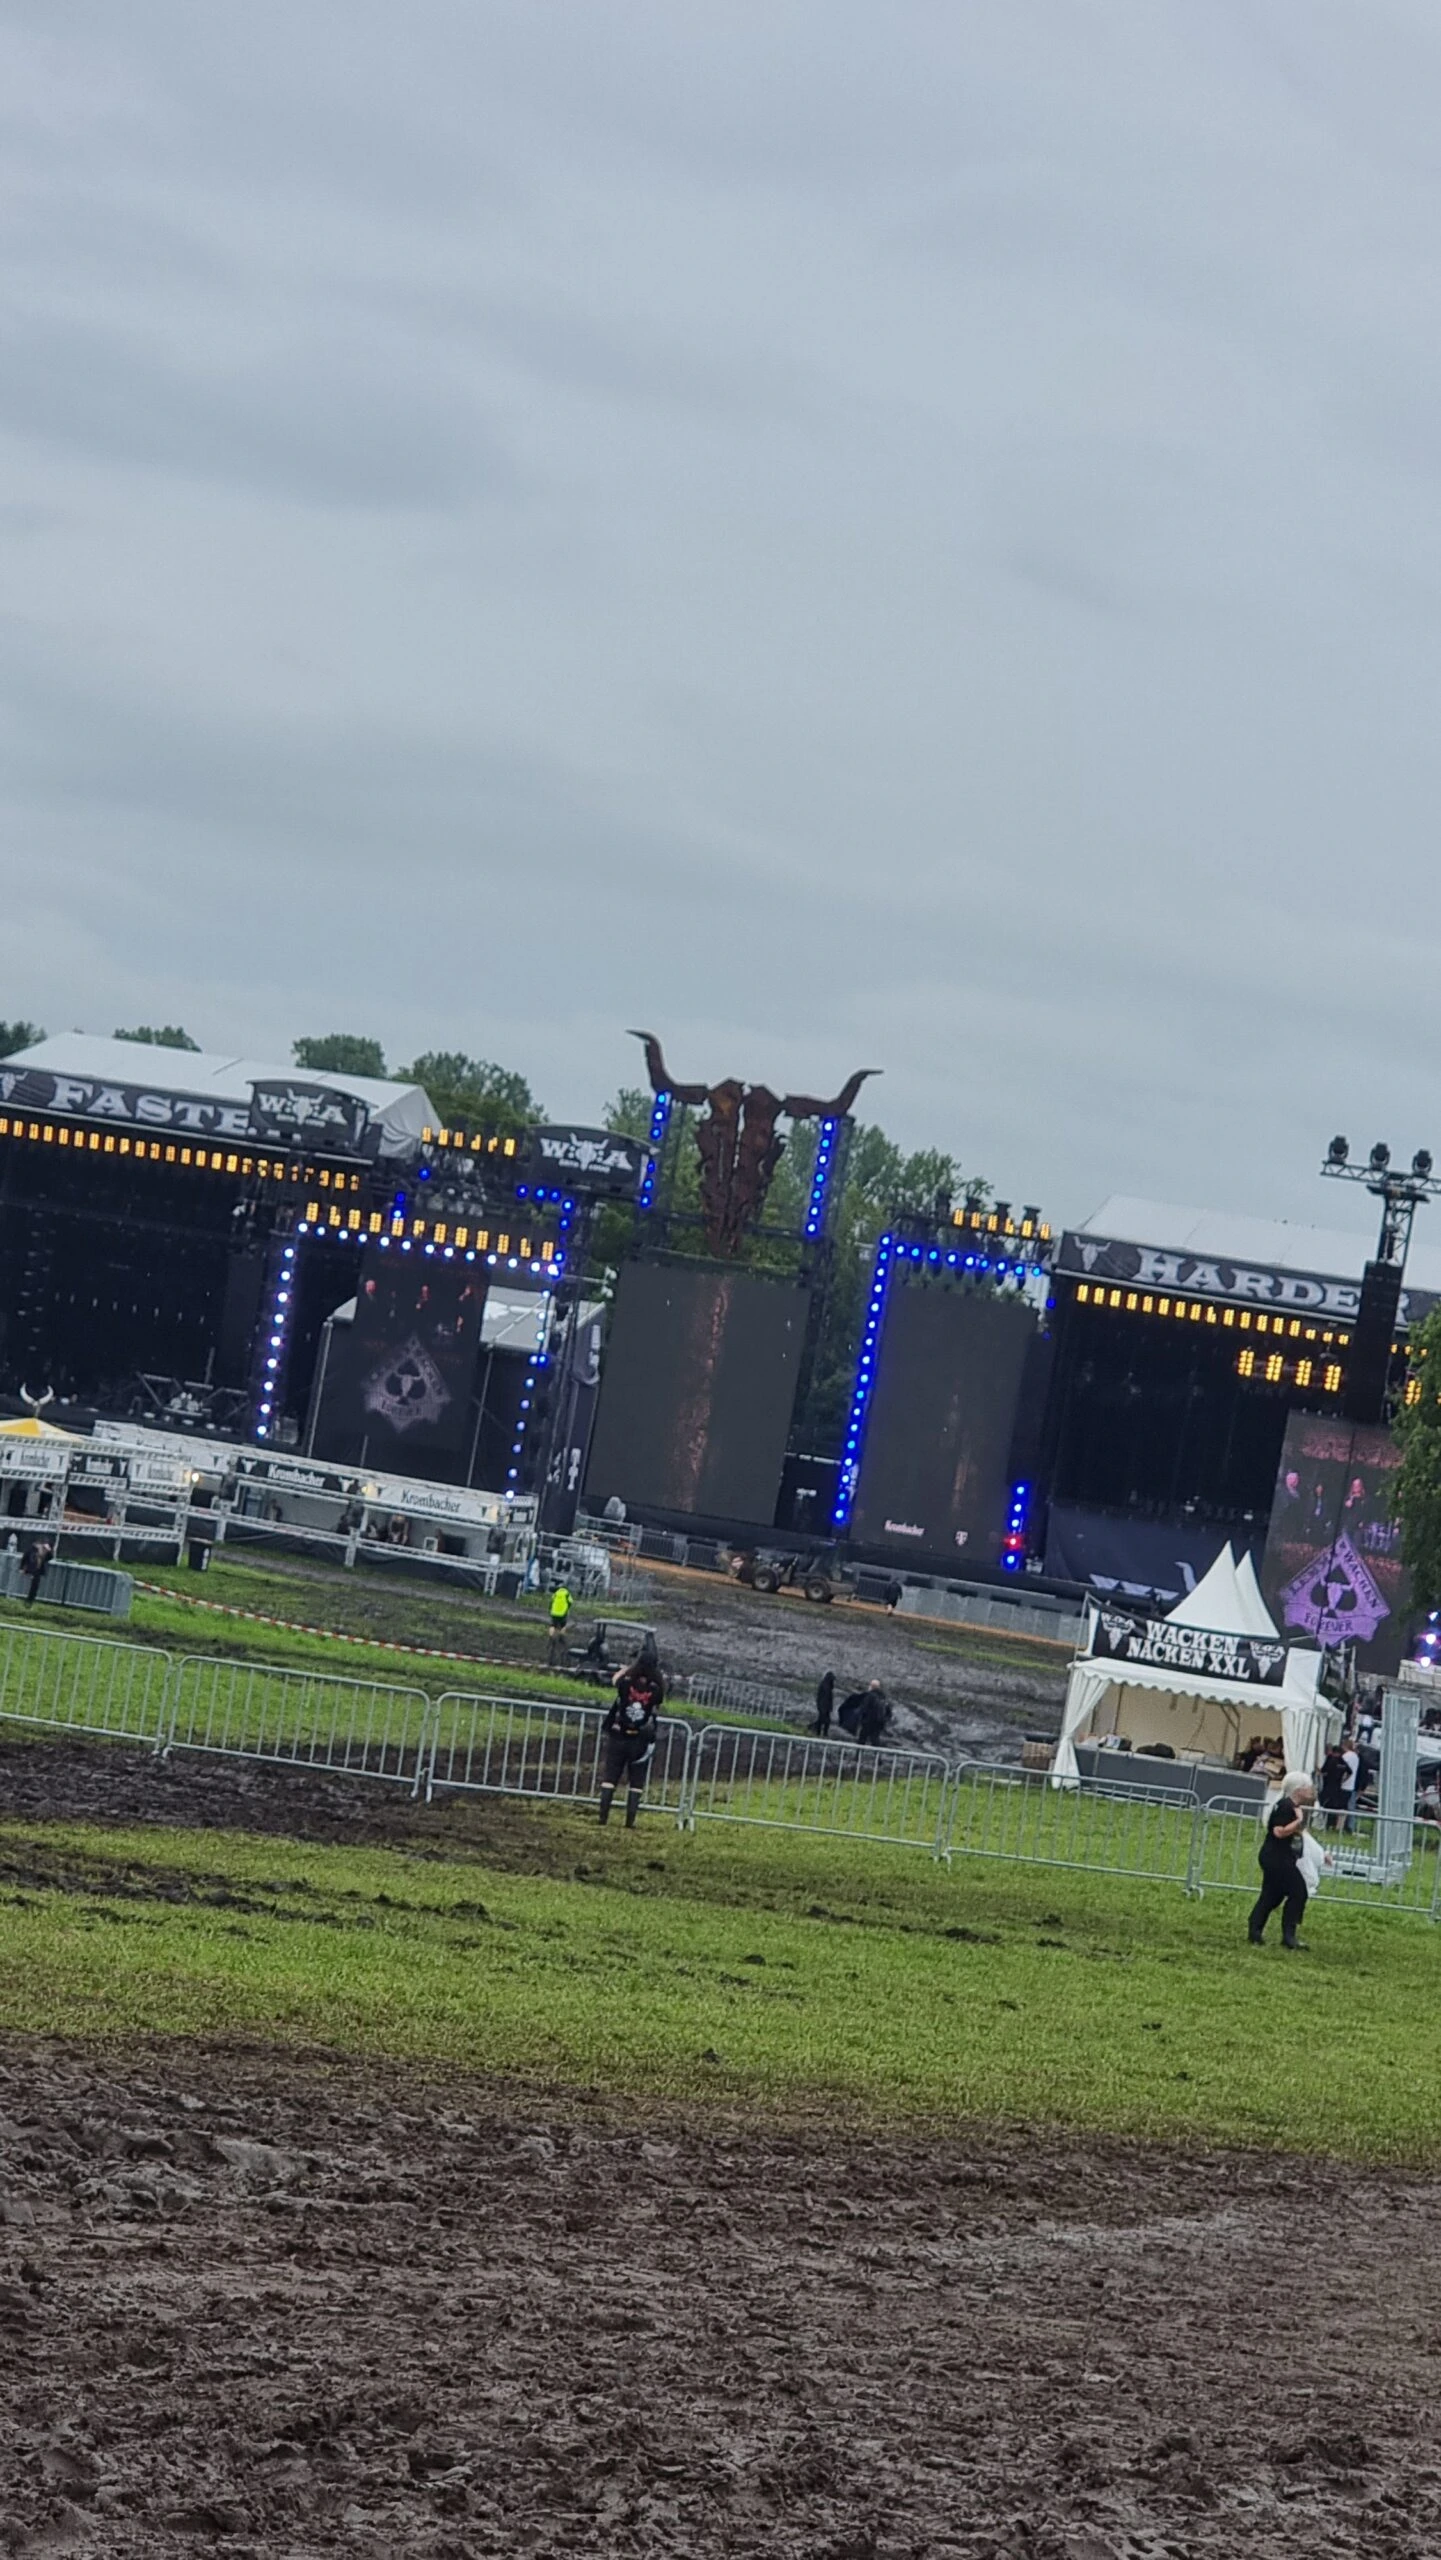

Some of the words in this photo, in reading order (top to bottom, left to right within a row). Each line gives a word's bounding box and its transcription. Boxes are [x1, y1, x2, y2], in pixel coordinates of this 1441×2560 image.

[47, 1075, 258, 1136] FASTE
[267, 1463, 326, 1488] Krombacher
[401, 1488, 461, 1513] Krombacher
[1343, 1550, 1378, 1608] WACKEN
[1146, 1619, 1241, 1654] WACKEN
[1126, 1636, 1206, 1669] NACKEN
[1208, 1653, 1251, 1679] XXL
